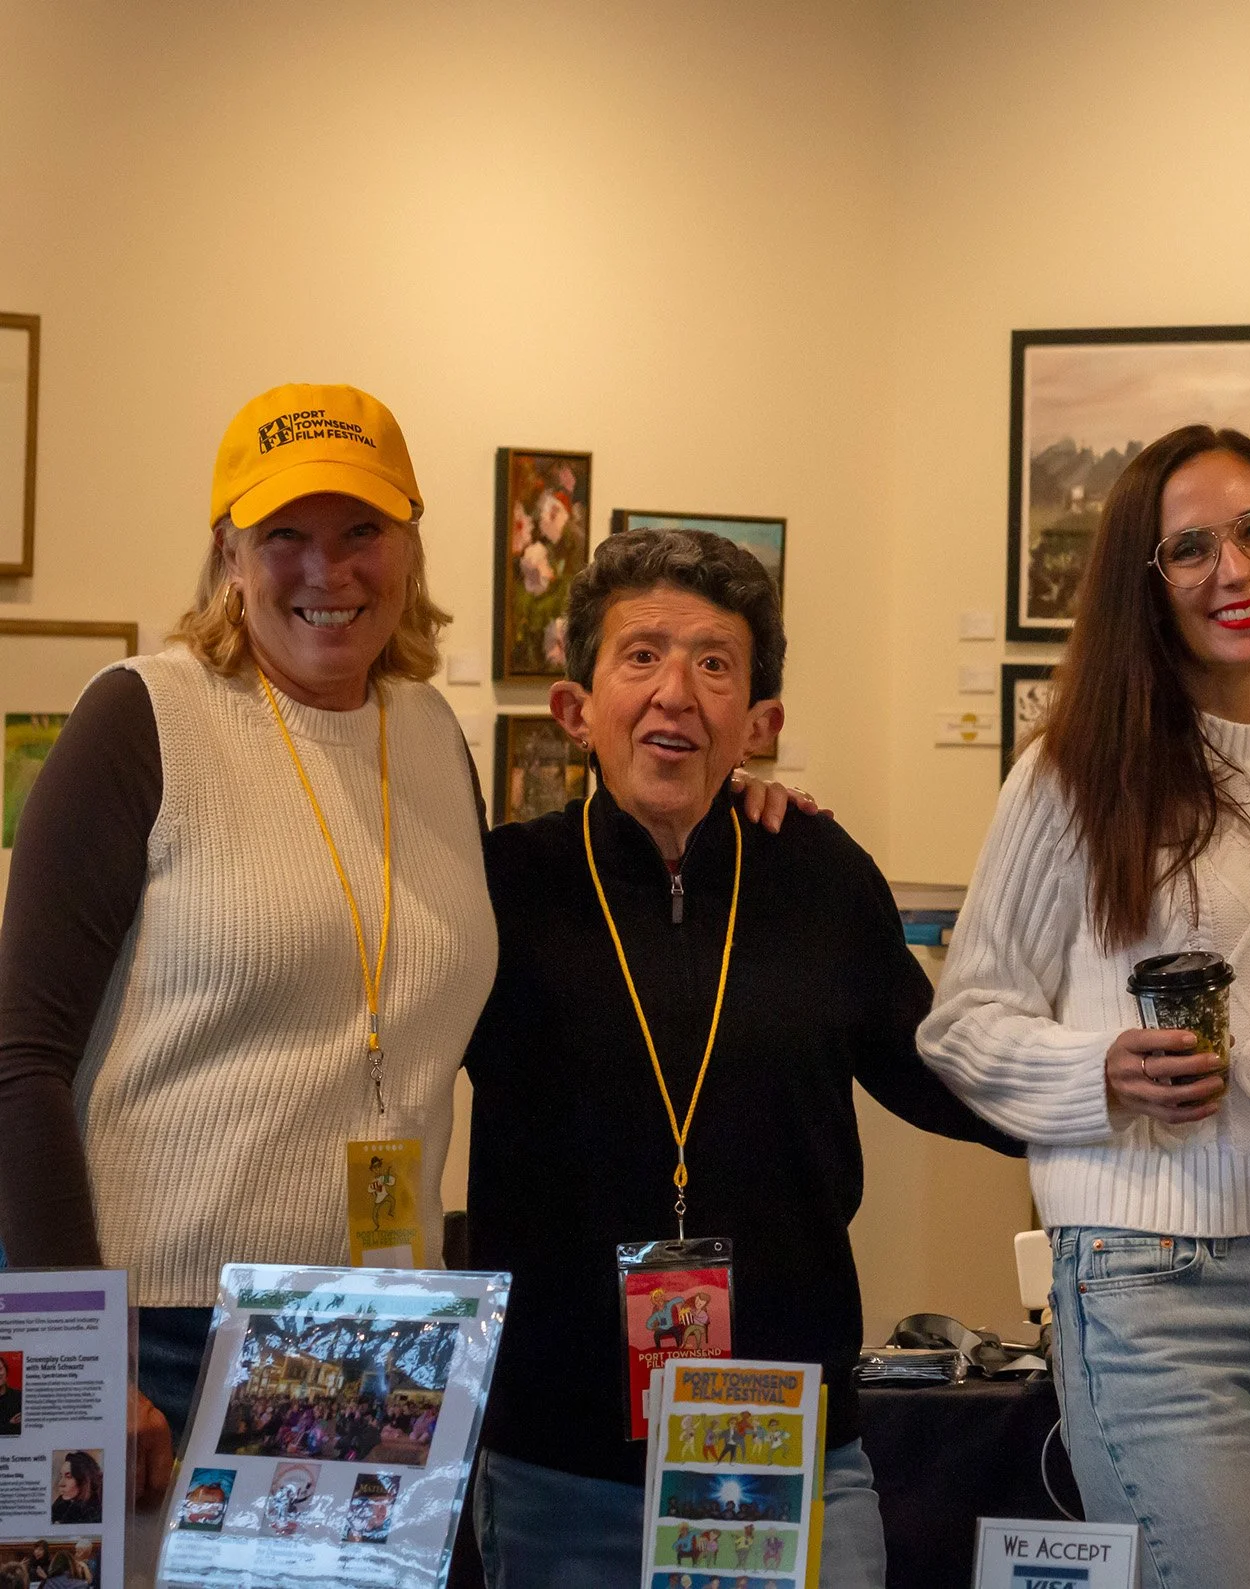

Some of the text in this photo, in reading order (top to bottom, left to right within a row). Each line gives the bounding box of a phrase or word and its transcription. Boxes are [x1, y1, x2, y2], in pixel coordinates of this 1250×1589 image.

[293, 410, 326, 421] PORT
[295, 419, 362, 433] TOWNSEND
[296, 429, 377, 449] FILM FESTIVAL
[639, 1348, 722, 1361] PORT TOWNSEND
[683, 1370, 798, 1390] PORT TOWNSEND
[692, 1385, 785, 1403] FILM FESTIVAL
